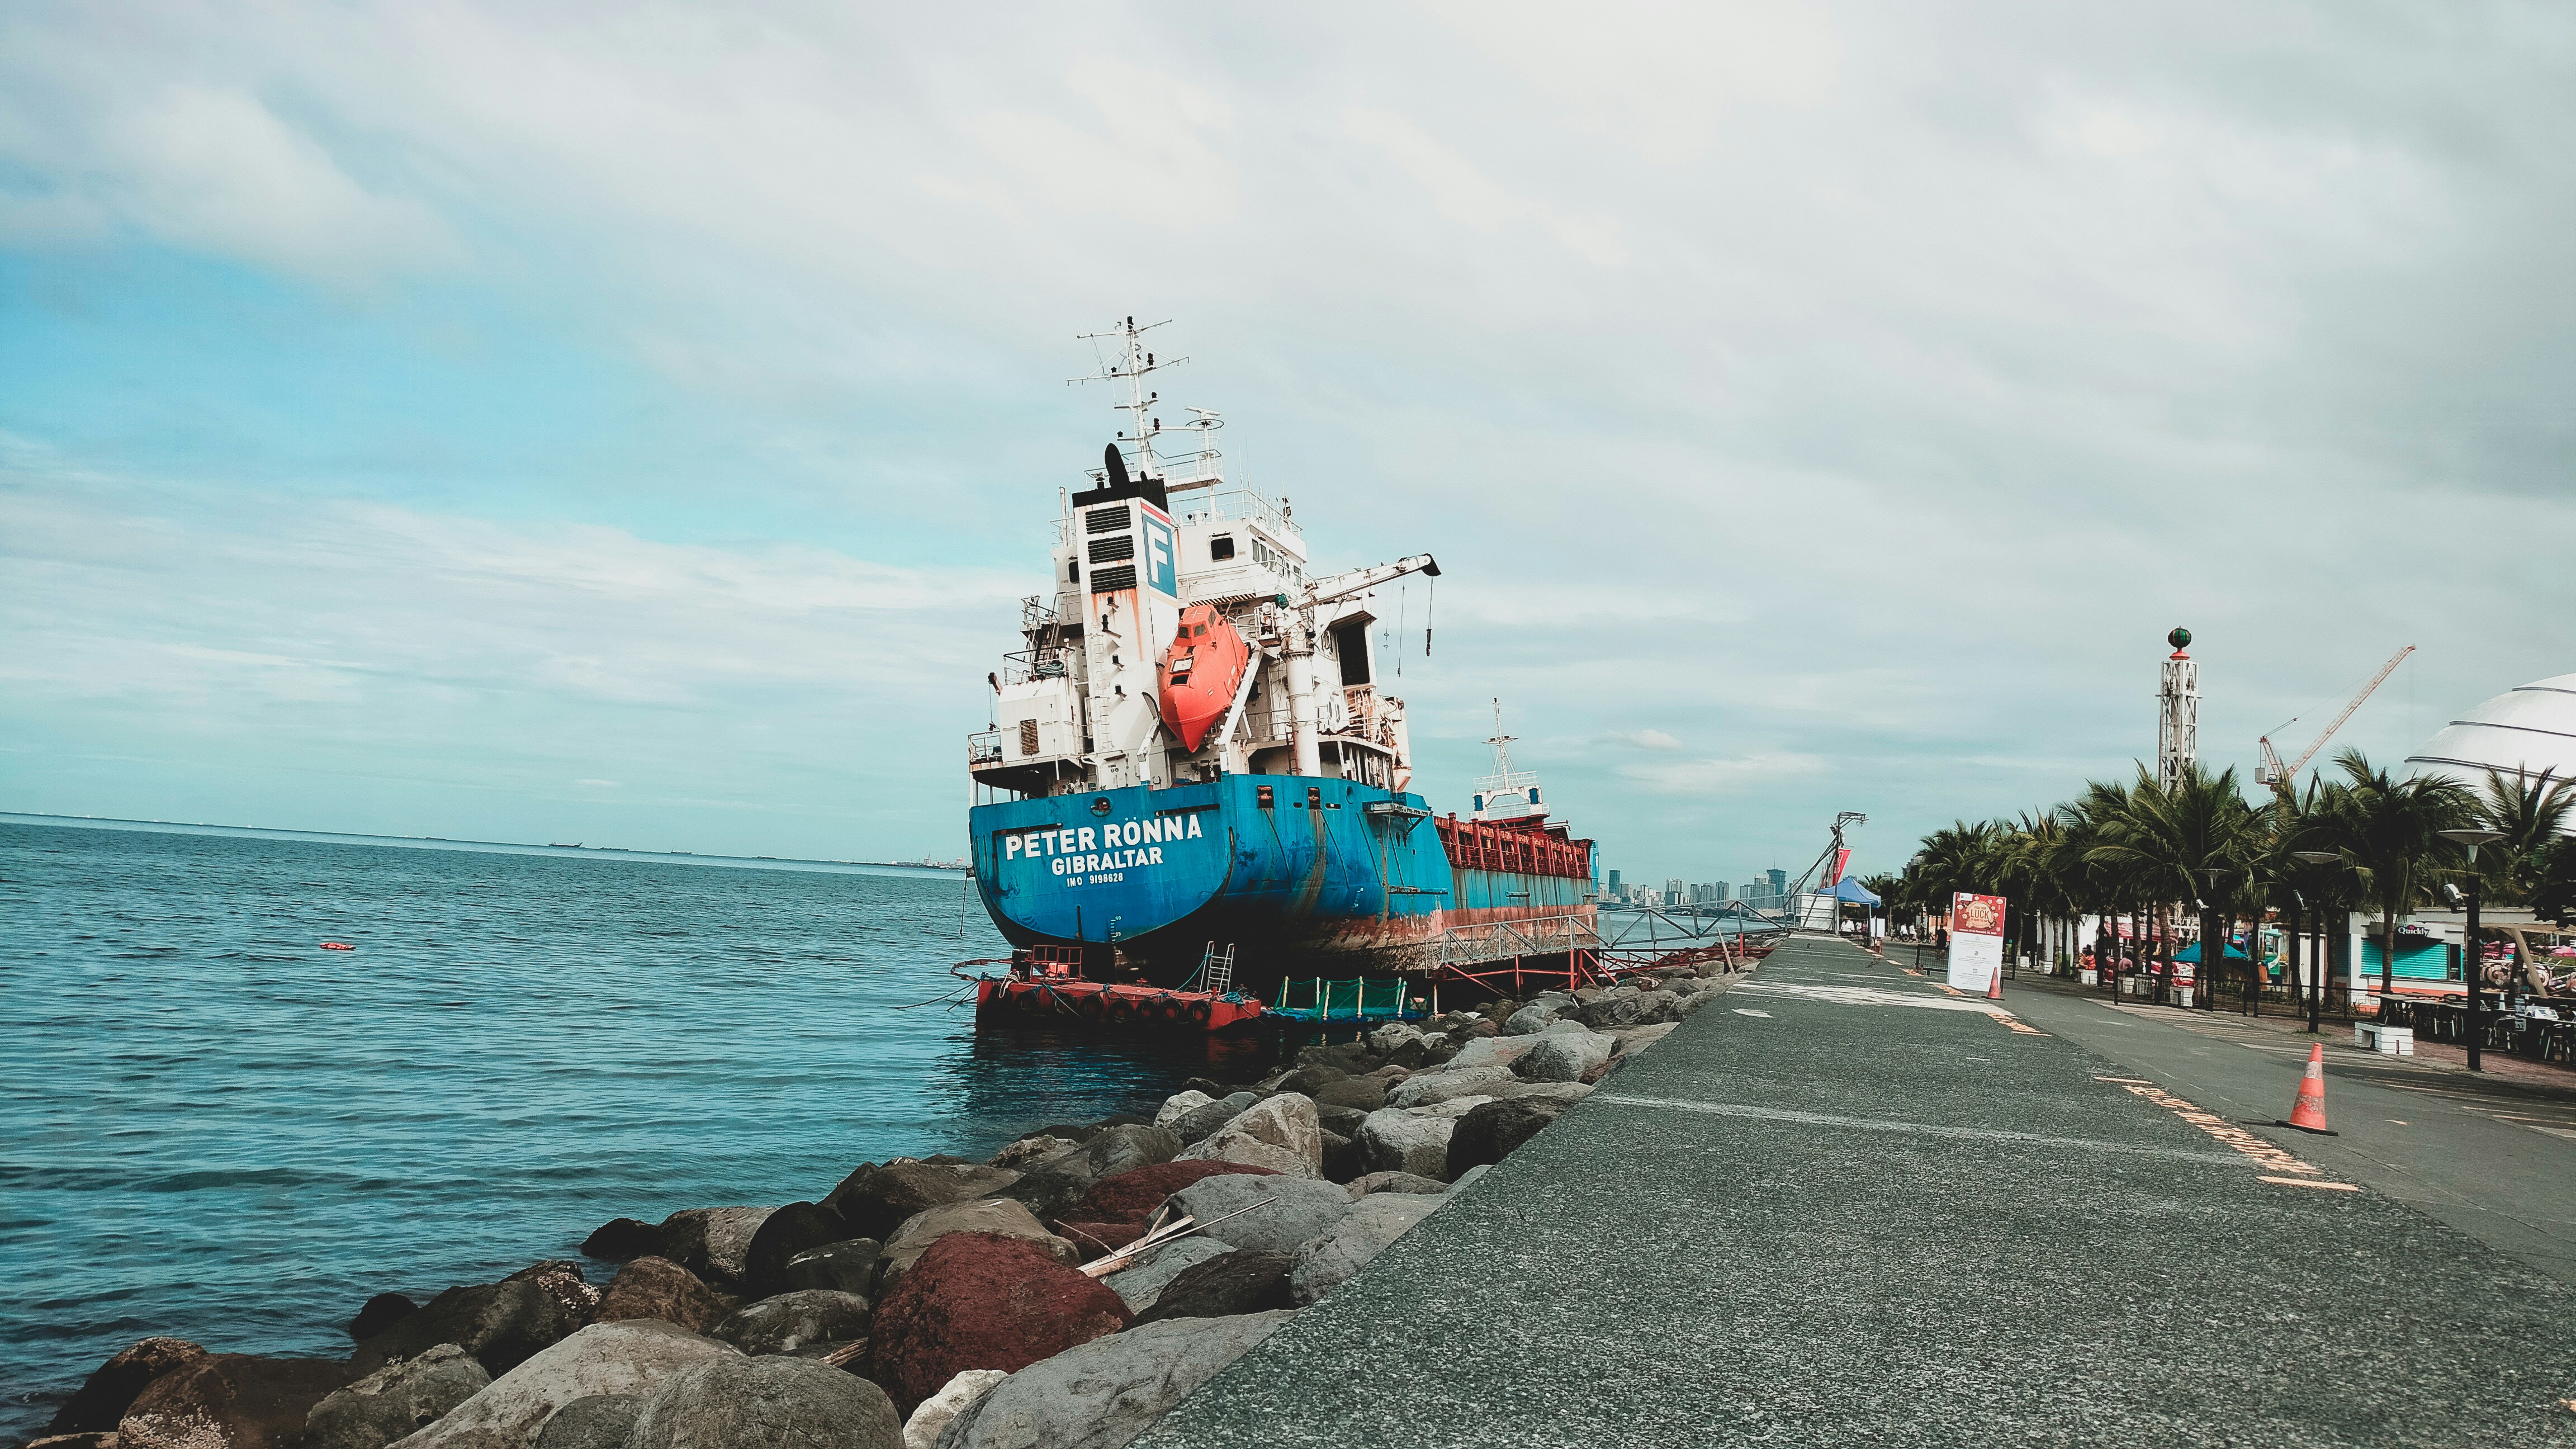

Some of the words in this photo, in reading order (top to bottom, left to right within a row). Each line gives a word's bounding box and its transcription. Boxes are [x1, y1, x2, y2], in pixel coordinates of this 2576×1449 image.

[1146, 521, 1169, 584] F
[1005, 827, 1097, 860] PETER
[1103, 814, 1202, 849] RÖNNA
[1052, 846, 1163, 875] GIBRALTAR
[1067, 877, 1083, 887] IMO
[1090, 872, 1124, 884] 9198628
[1971, 909, 1990, 919] LUCK
[2398, 927, 2428, 937] Quickly
